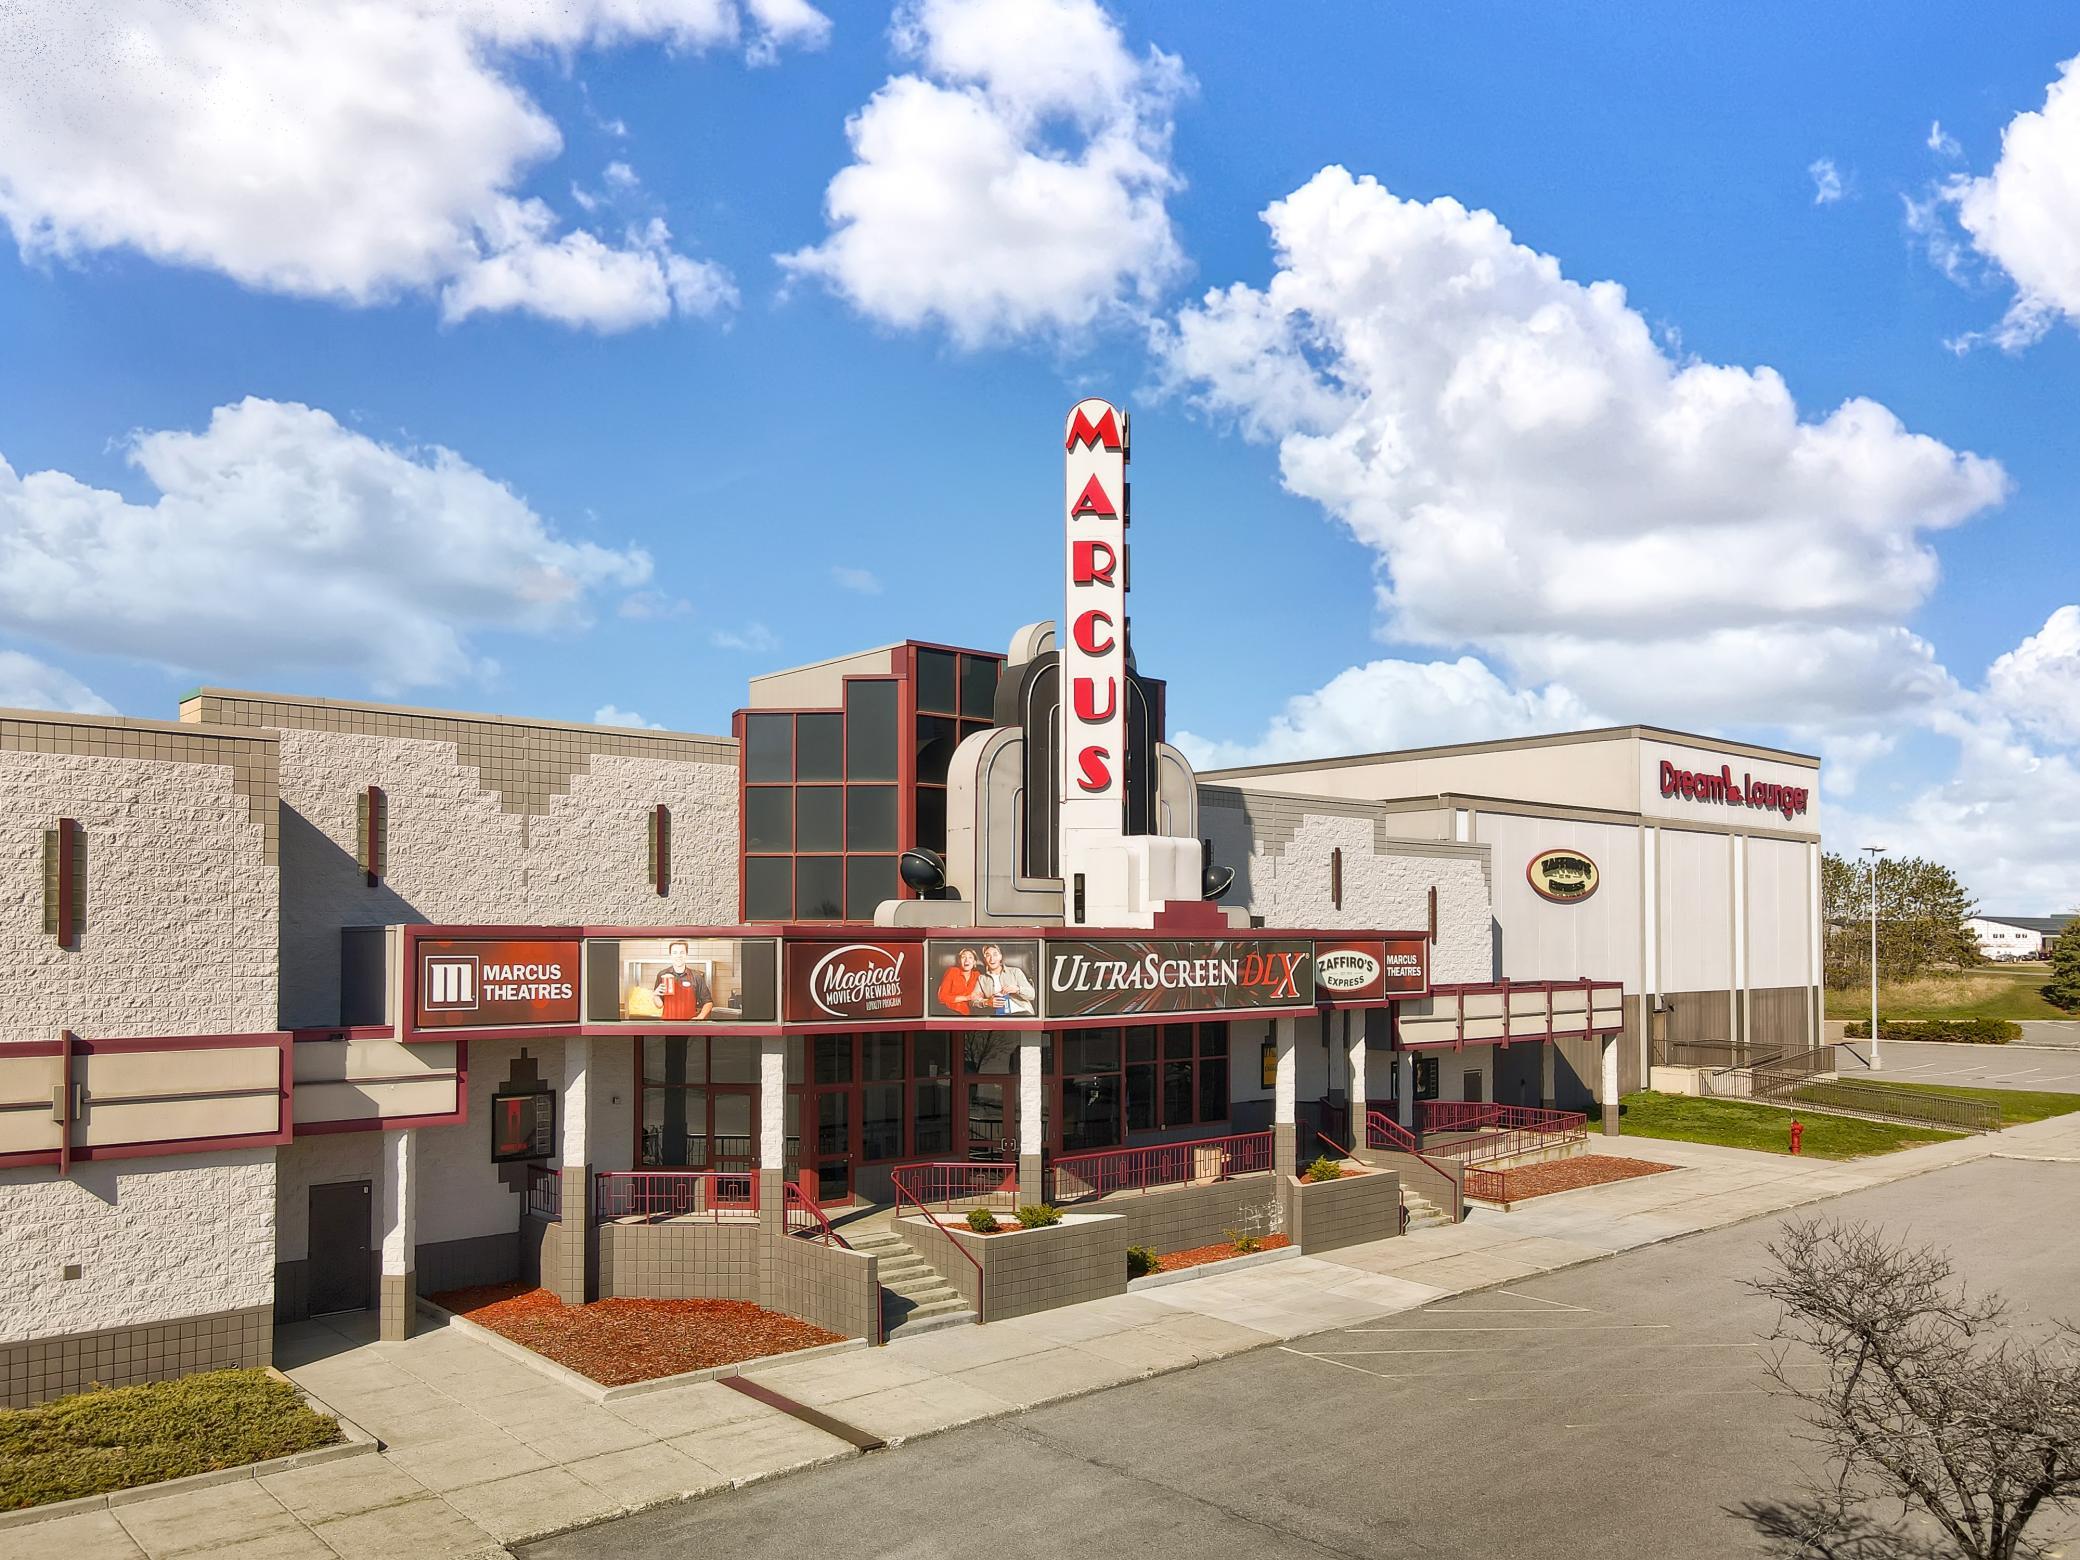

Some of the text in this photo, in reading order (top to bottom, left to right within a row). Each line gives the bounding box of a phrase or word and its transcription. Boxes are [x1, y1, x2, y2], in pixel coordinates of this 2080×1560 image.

[1066, 407, 1122, 790] MARCUS
[1660, 760, 1809, 818] Dream Lounger
[1318, 956, 1374, 973] ZAFFIRO'S
[1386, 954, 1417, 965] MARCUS
[483, 964, 562, 981] MARCUS
[823, 952, 905, 1002] Magical
[1386, 966, 1422, 977] THEATRES
[1327, 975, 1365, 987] EXPRESS
[483, 983, 573, 1001] THEATRES
[826, 982, 901, 1006] MOVIE REWARDS
